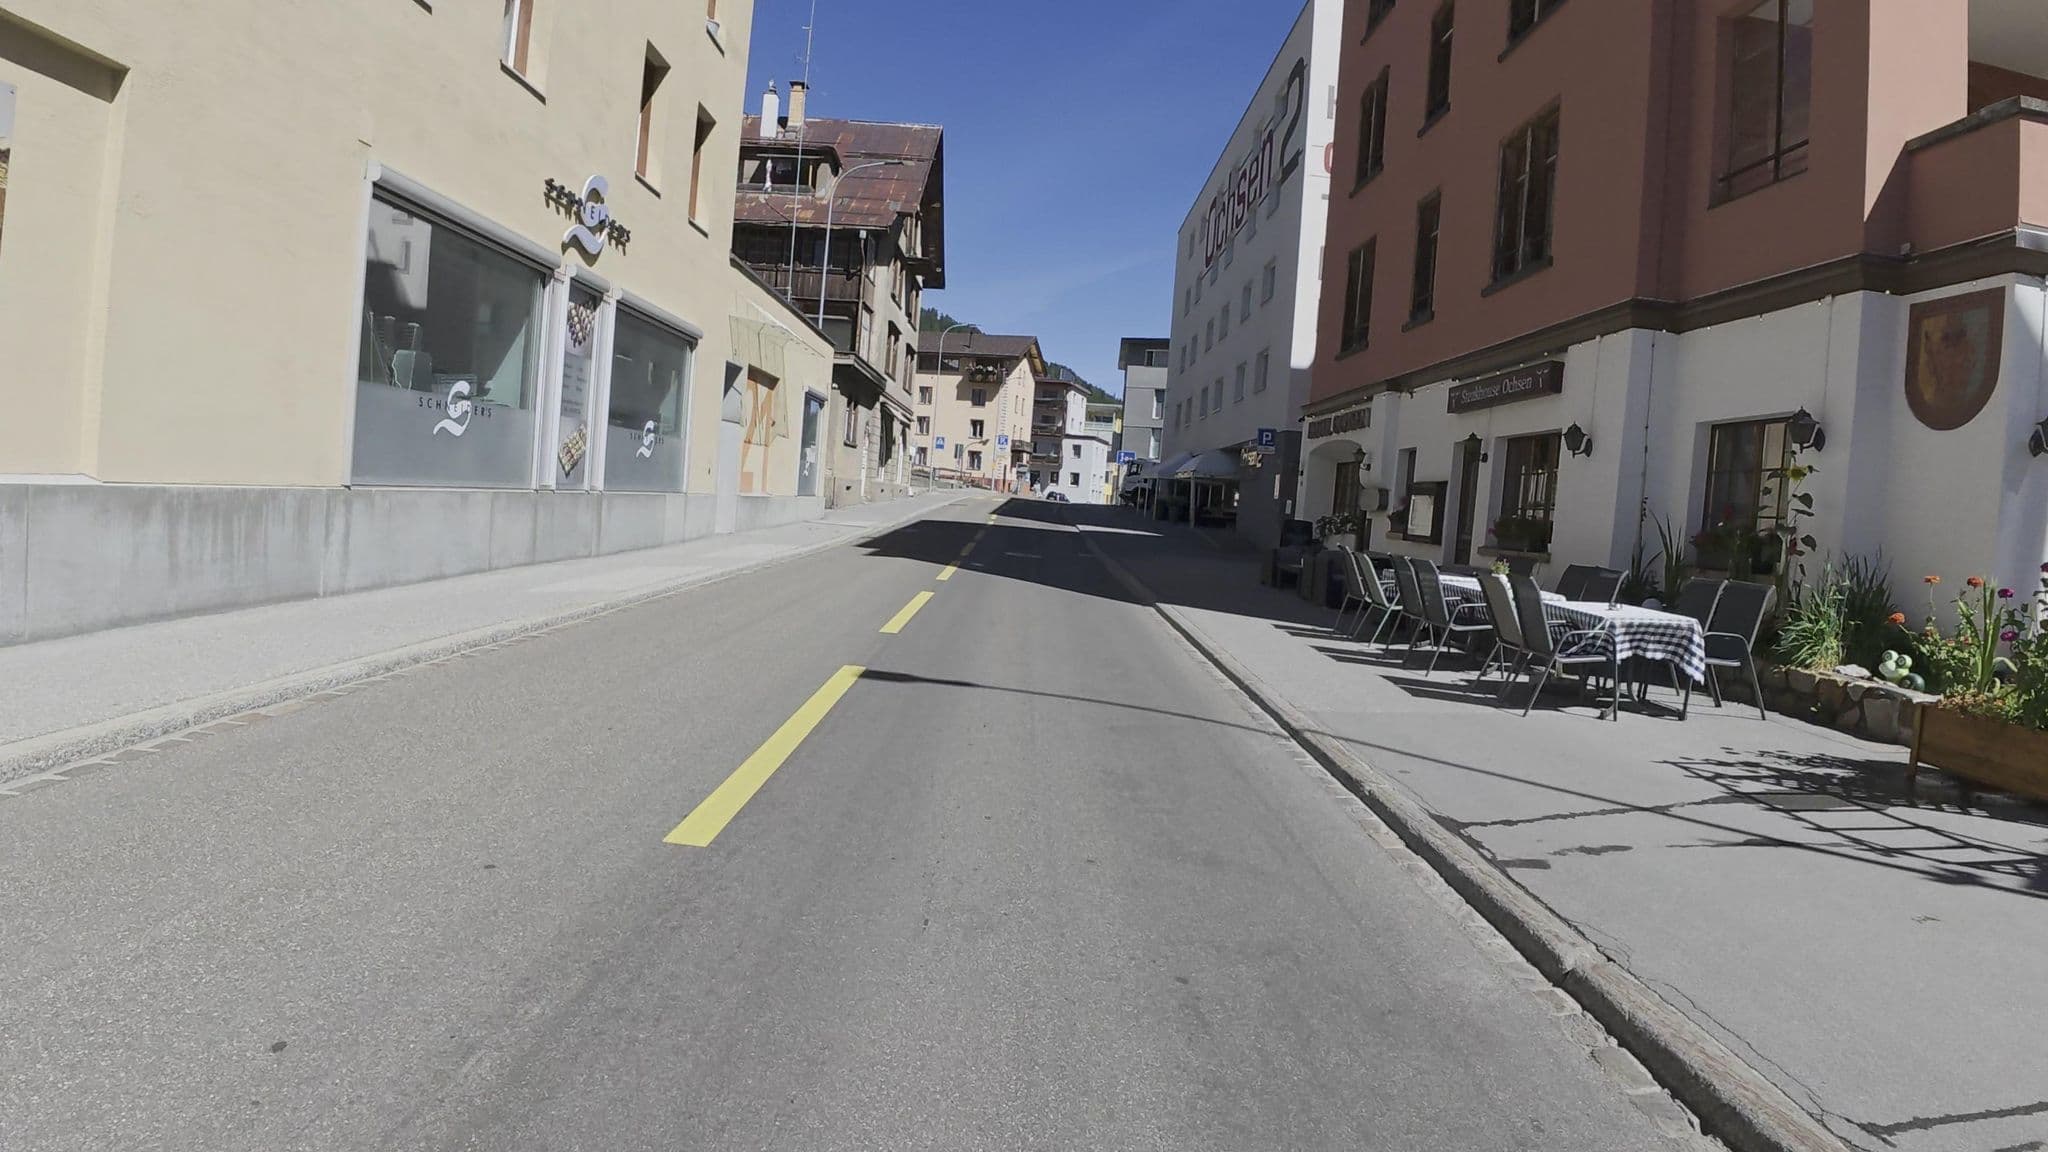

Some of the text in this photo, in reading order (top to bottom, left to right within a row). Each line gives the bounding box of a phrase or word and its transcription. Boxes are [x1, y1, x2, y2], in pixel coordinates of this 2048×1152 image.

[1204, 57, 1306, 268] Ochsen 2
[1502, 376, 1533, 394] Ochsen
[1263, 431, 1272, 445] P
